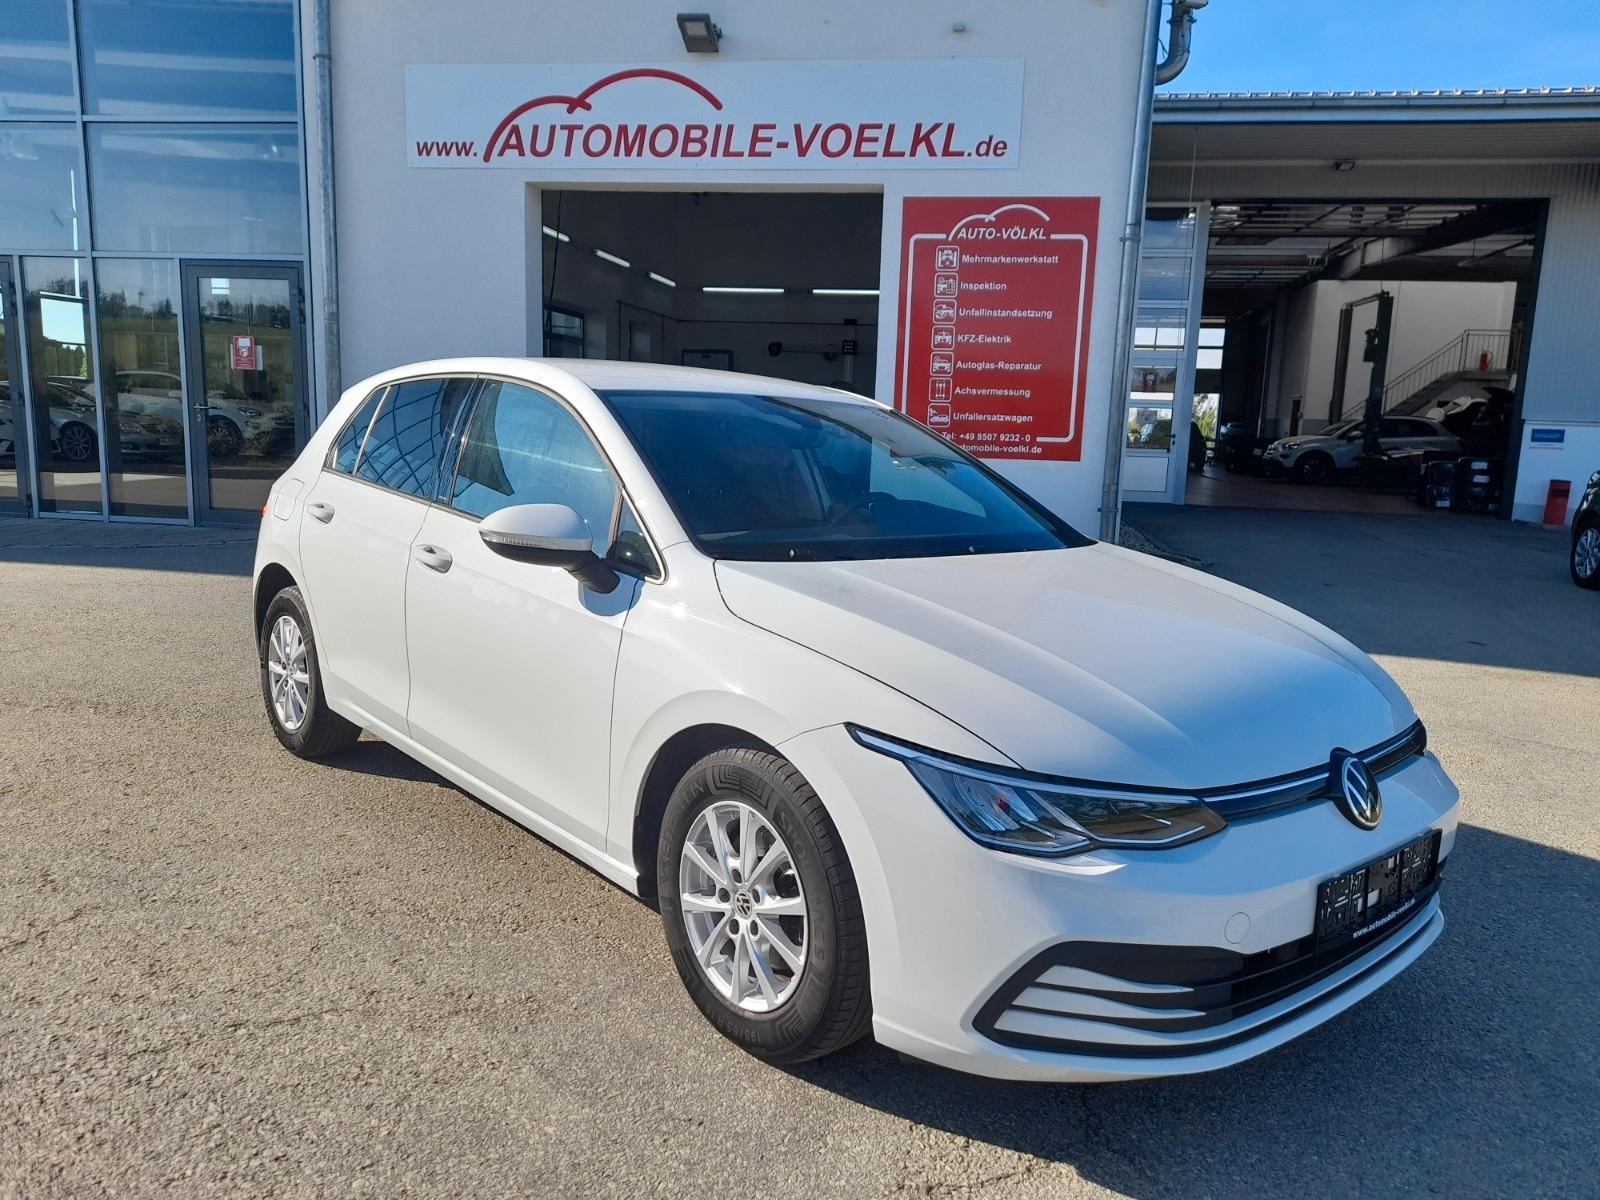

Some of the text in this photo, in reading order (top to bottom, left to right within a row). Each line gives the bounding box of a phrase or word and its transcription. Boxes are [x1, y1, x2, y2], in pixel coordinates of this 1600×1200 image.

[957, 226, 1047, 240] AUTO-VÖLKL
[962, 254, 1059, 264] Mehrmarkenwerkstatt
[960, 281, 1007, 291] Inspektion
[959, 308, 1053, 319] Unfallinstandsetzung
[957, 335, 1012, 344] KFZ-Elektrik
[955, 360, 1042, 371] Autoglas-Reparatur
[954, 387, 1031, 398] Achsvermessung
[953, 413, 1033, 423] Unfallersatzwagen
[960, 433, 975, 441] +49
[977, 433, 997, 441] 8507
